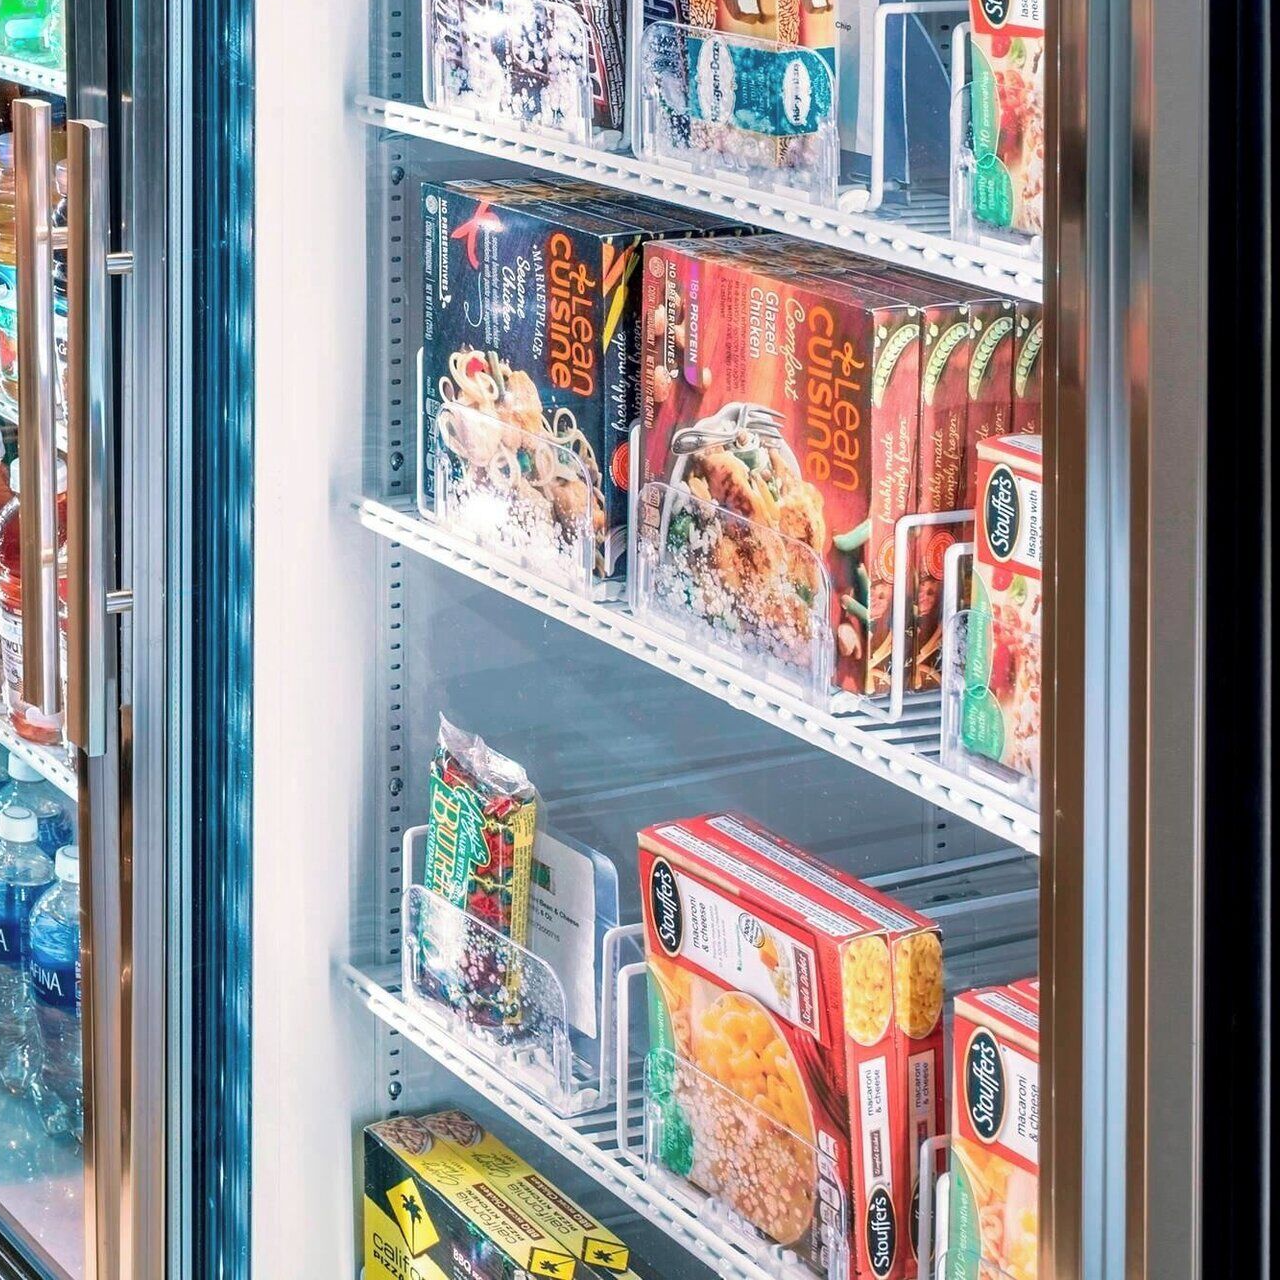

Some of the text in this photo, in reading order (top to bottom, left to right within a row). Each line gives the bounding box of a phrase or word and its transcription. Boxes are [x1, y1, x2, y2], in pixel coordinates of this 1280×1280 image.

[835, 21, 851, 31] Chip
[1031, 0, 1040, 22] meat
[440, 199, 449, 292] NO PRESERVATIVES
[502, 265, 517, 334] Chicken
[516, 254, 531, 320] Sesame
[532, 250, 546, 357] MARKETPLACE
[667, 262, 676, 365] NO PRESERVATIVES
[689, 279, 699, 363] 18g PROTEIN
[749, 286, 764, 360] Chicken
[571, 294, 595, 397] Lean
[764, 291, 780, 357] Glazed
[780, 297, 807, 402] Comfort
[833, 376, 861, 492] Lean
[991, 474, 1013, 552] Stouffer's
[1026, 488, 1038, 559] lasagna with
[658, 869, 677, 948] Stouffer's
[689, 894, 700, 948] macaroni
[972, 1041, 996, 1131] Stouffer's
[1017, 1073, 1028, 1138] macaroni
[456, 1191, 518, 1245] california
[465, 1188, 525, 1241] PIZZA KITCHEN
[508, 1184, 571, 1236] california
[517, 1180, 578, 1232] PIZZA KITCHEN
[873, 1195, 890, 1268] Stouffer's
[958, 1191, 969, 1264] preservatives
